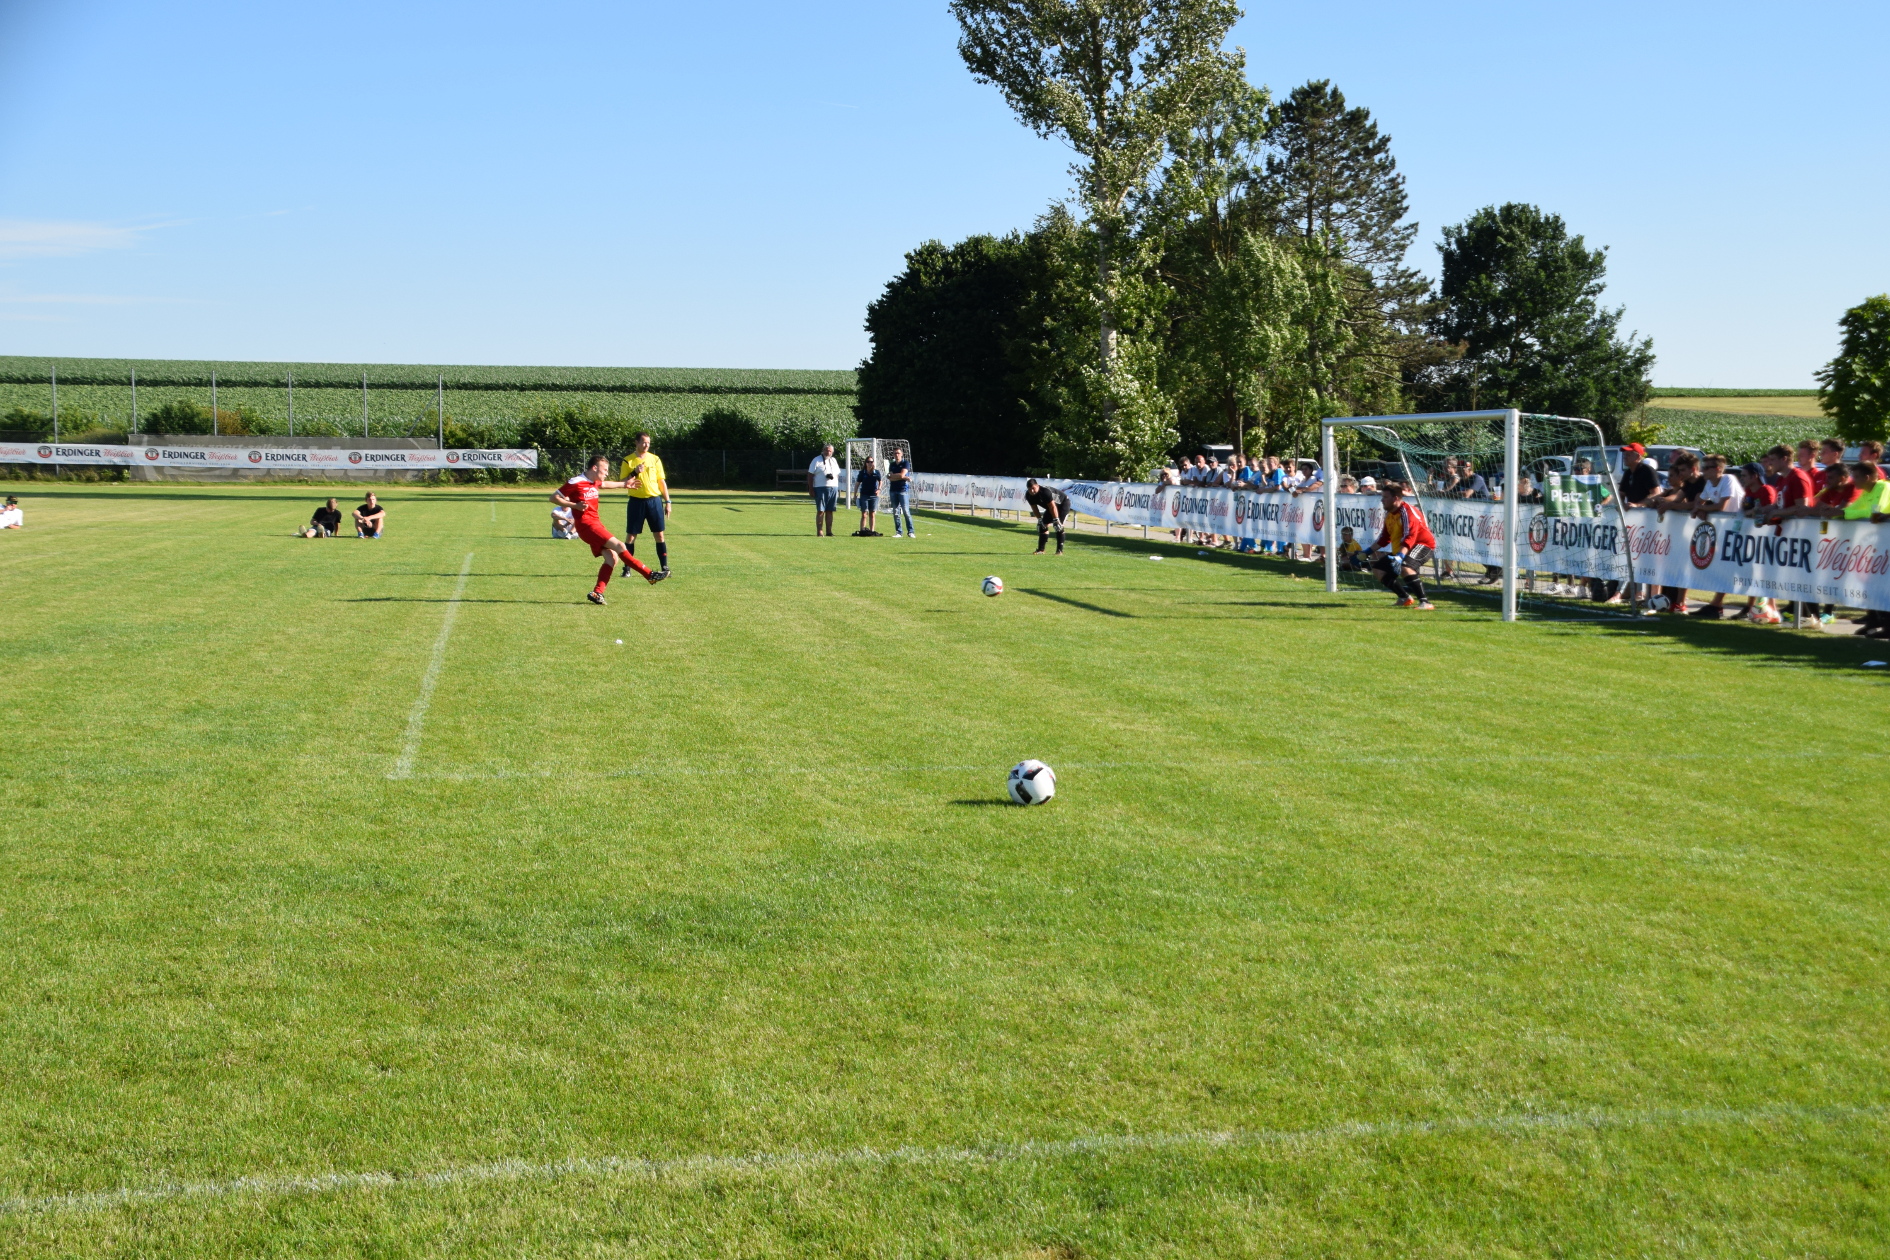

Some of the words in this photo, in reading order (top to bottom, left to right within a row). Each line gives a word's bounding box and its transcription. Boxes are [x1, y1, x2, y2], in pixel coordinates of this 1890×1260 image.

[56, 448, 101, 457] ERDINGER
[162, 450, 206, 460] ERDINGER
[265, 453, 307, 462] ERDINGER
[365, 453, 406, 462] ERDINGER
[462, 453, 503, 461] ERDINGER
[1124, 492, 1150, 511] ERDINGER
[1551, 489, 1582, 502] Platz
[1586, 490, 1594, 502] 1
[1181, 496, 1208, 517] ERDINGER
[1247, 500, 1279, 524] ERDINGER
[1336, 508, 1366, 531] DINGER
[1552, 519, 1617, 554] ERDINGER
[1720, 530, 1812, 573] ERDINGER
[1816, 537, 1890, 580] Weißbier
[1733, 577, 1812, 594] PRIVATBRAUEREI
[1816, 585, 1839, 597] SEIT
[1843, 588, 1868, 600] 1886
